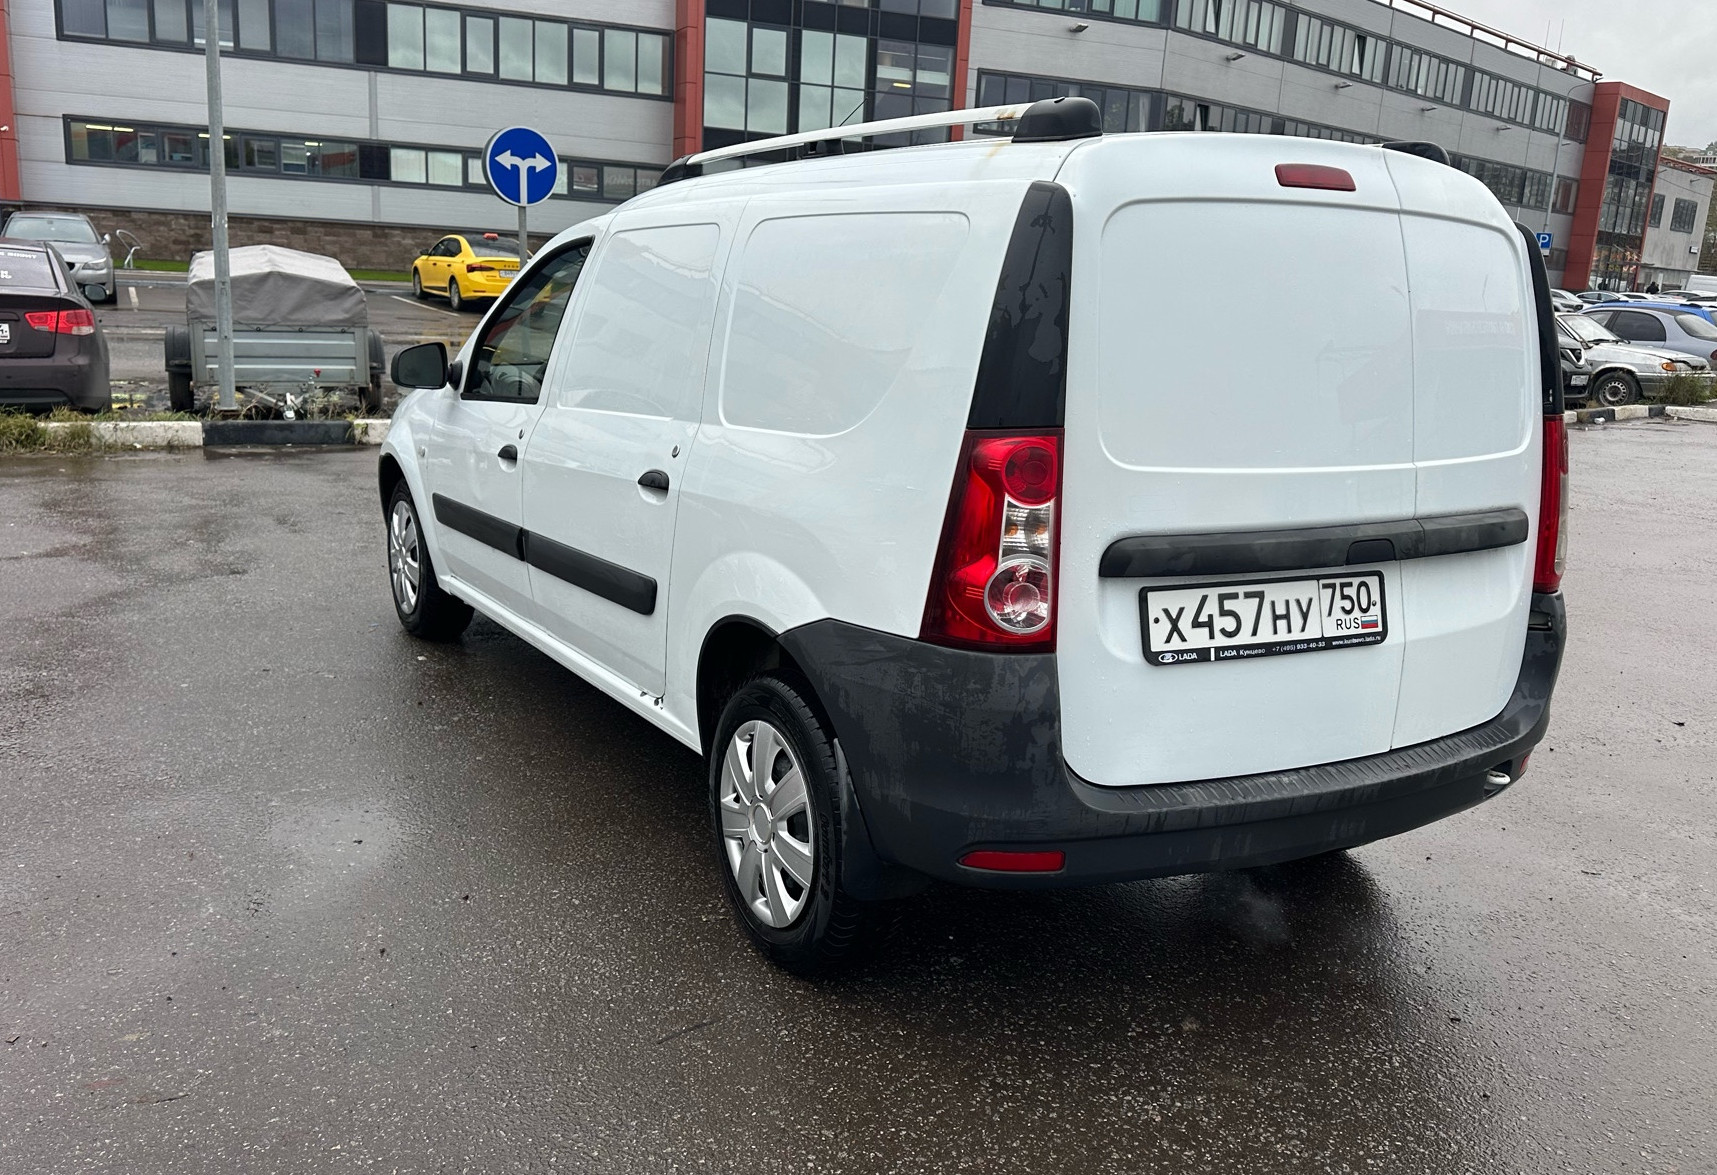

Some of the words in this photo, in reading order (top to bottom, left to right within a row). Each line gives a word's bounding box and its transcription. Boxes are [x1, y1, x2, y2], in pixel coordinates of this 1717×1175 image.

[1539, 234, 1549, 247] P
[1161, 590, 1314, 644] Х457НУ
[1321, 580, 1372, 617] 750
[1336, 617, 1361, 631] RUS
[1178, 652, 1198, 661] LADA
[1219, 648, 1238, 657] LADA
[1239, 647, 1266, 657] Кунцево
